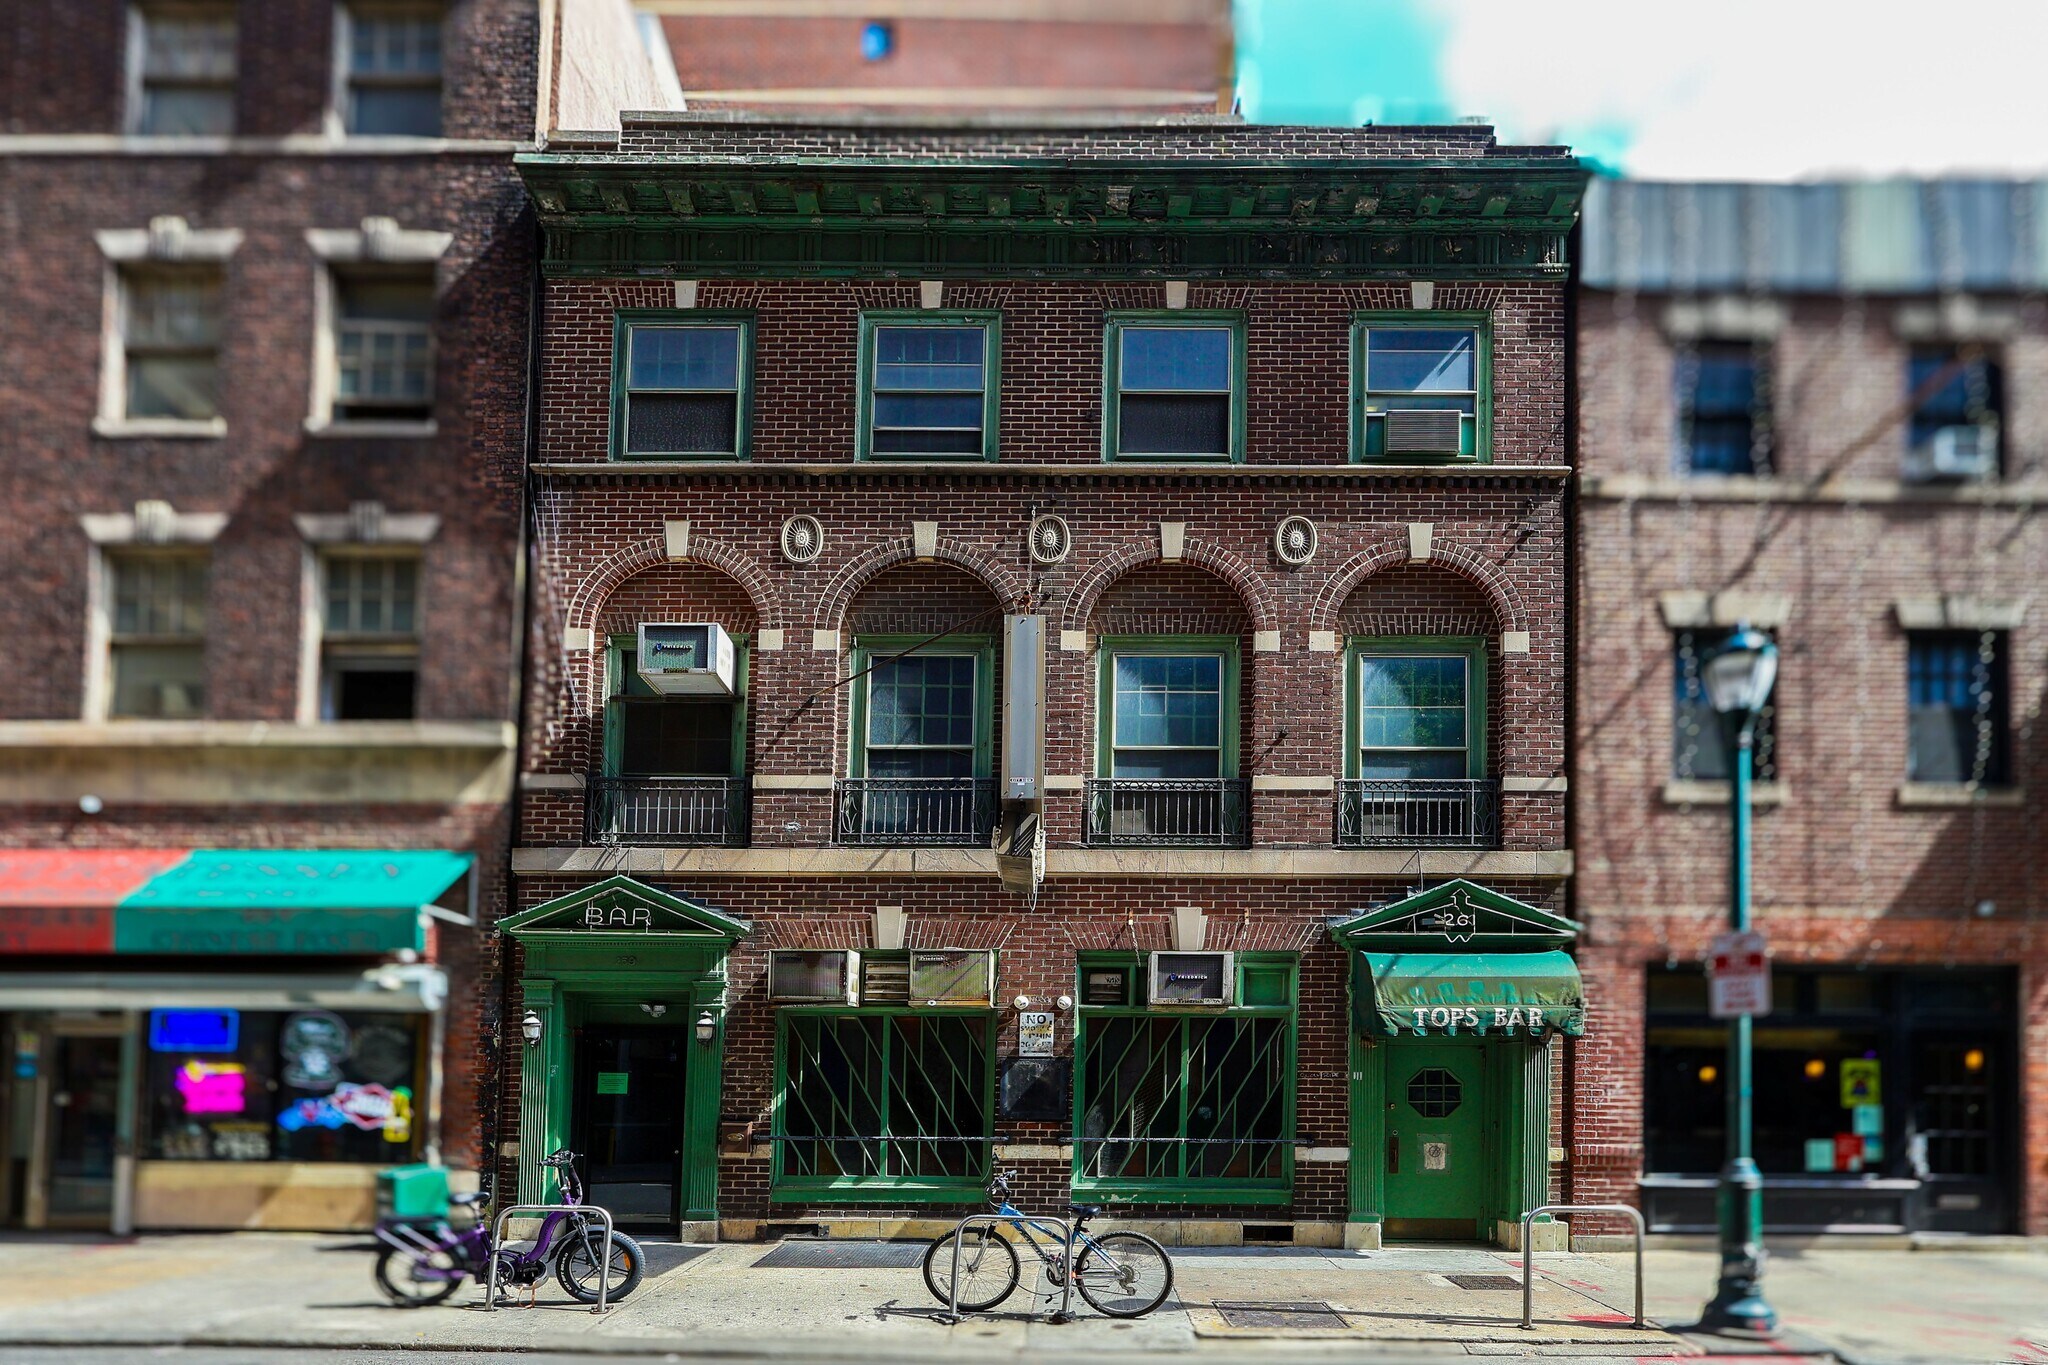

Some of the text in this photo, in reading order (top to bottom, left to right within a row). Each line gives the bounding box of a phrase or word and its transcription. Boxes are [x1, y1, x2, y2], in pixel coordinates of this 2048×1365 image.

[585, 907, 651, 926] BAR
[1026, 1014, 1047, 1024] NO
[1412, 1007, 1545, 1027] TOPS BAR
